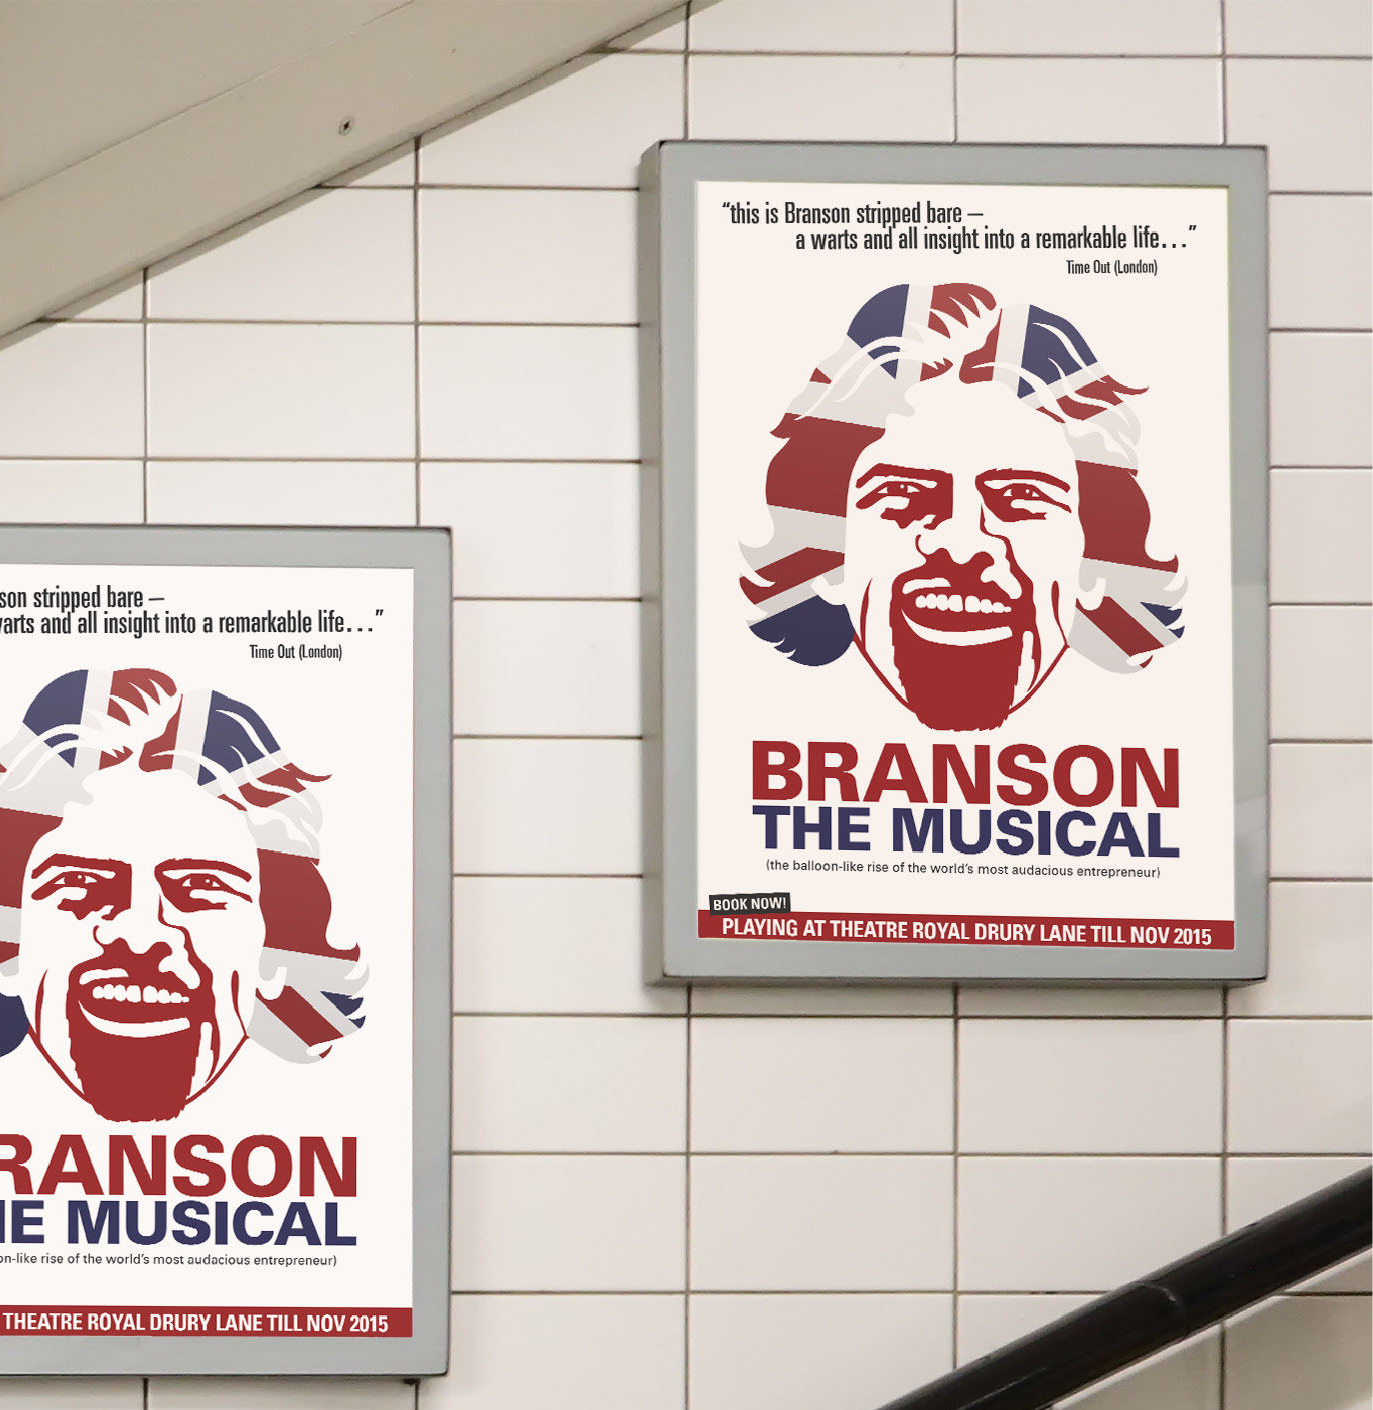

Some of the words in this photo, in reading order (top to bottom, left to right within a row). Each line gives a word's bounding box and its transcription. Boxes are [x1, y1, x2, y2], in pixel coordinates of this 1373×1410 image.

[765, 201, 779, 225] is
[784, 201, 851, 225] Branson
[856, 200, 921, 231] stripped
[926, 200, 962, 224] bare
[795, 233, 806, 250] a
[810, 229, 858, 250] warts
[863, 225, 893, 250] and
[898, 225, 918, 250] all
[923, 225, 980, 255] insight
[984, 224, 1015, 250] into
[1020, 232, 1030, 249] a
[1035, 224, 1127, 250] remarkable
[1065, 259, 1091, 275] Time
[1093, 259, 1111, 274] Out
[1113, 259, 1158, 277] (London)
[33, 584, 101, 615] stripped
[107, 584, 144, 608] bare
[40, 610, 72, 635] and
[77, 610, 98, 634] all
[103, 609, 161, 639] insight
[165, 610, 197, 634] into
[202, 616, 214, 634] a
[219, 609, 312, 634] remarkable
[248, 644, 275, 659] Time
[277, 643, 296, 659] Out
[298, 643, 343, 662] (London)
[752, 740, 1180, 809] BRANSON
[752, 805, 871, 851] THE
[892, 807, 1180, 858] MUSICAL
[722, 917, 798, 937] PLAYING
[802, 919, 827, 937] AT
[829, 919, 908, 939] THEATRE
[912, 921, 971, 940] ROYAL
[974, 922, 1036, 942] DRURY
[1040, 924, 1087, 943] LANE
[1089, 925, 1127, 943] TILL
[1130, 926, 1171, 945] NOV
[1173, 927, 1212, 946] 2015
[67, 1200, 357, 1246] MUSICAL
[2, 1312, 83, 1330] THEATRE
[87, 1312, 146, 1332] ROYAL
[149, 1313, 212, 1332] DRURY
[216, 1313, 263, 1332] LANE
[266, 1314, 303, 1332] TILL
[306, 1313, 346, 1333] NOV
[349, 1314, 389, 1333] 2015
